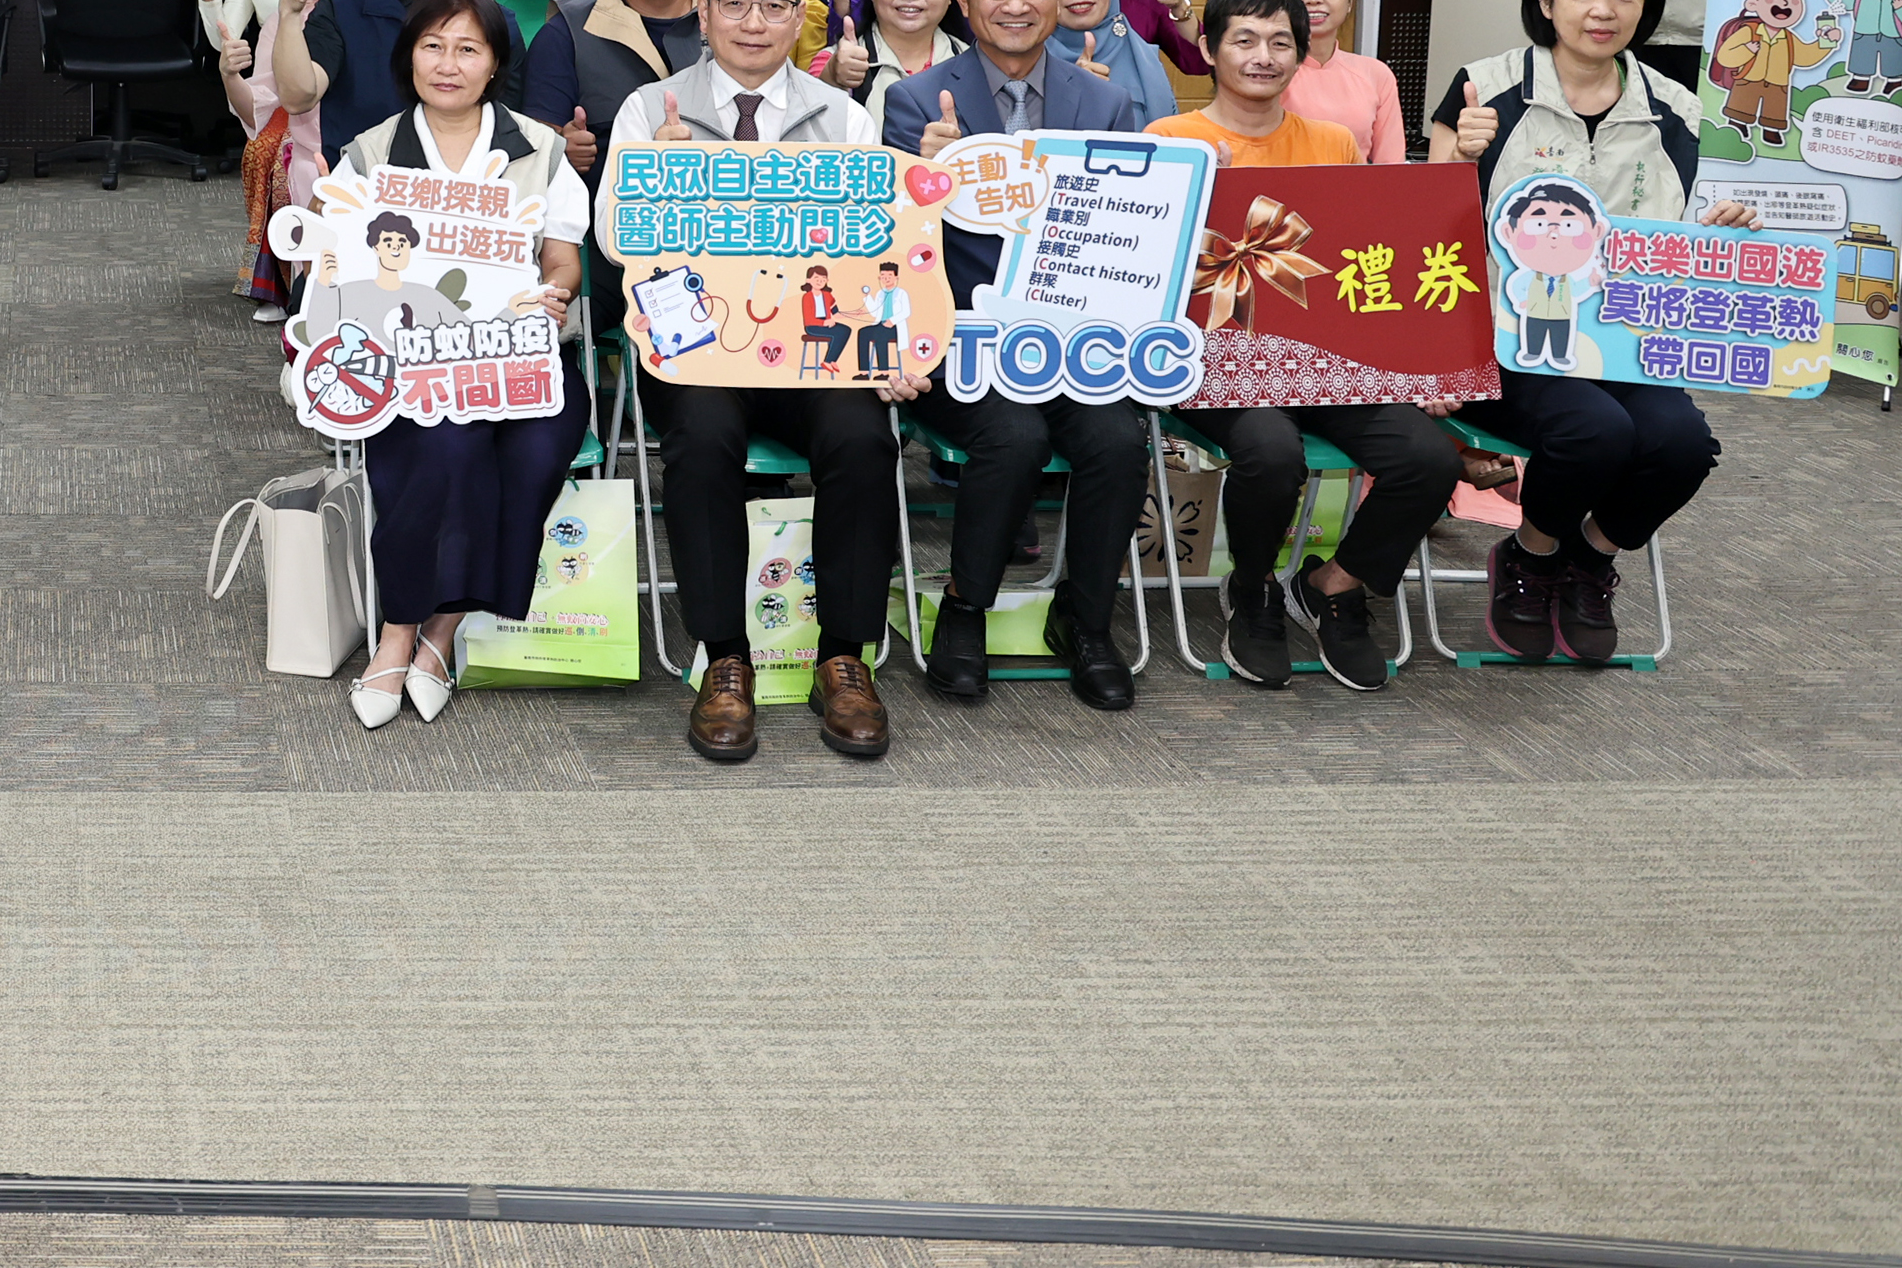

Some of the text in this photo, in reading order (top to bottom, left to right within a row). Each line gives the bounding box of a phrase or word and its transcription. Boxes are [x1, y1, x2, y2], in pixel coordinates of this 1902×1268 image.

[1812, 111, 1902, 135] 使用衛生福利部核
[374, 171, 511, 219] 返鄉探親
[614, 149, 895, 203] 民眾自主通報
[1054, 174, 1100, 193] 旅遊史
[974, 181, 1035, 216] 告知
[1045, 207, 1091, 226] 職業別
[1050, 191, 1170, 220] (Travel history)
[425, 221, 528, 265] 出遊玩
[613, 203, 895, 257] 醫師主動問診
[1036, 240, 1081, 259] 接觸史
[1042, 224, 1140, 251] (Occupation)
[1029, 271, 1058, 289] 群聚
[1033, 256, 1161, 290] (Contact history)
[1334, 241, 1481, 313] 禮券
[1603, 227, 1827, 291] 快樂出國遊
[1025, 288, 1088, 311] (Cluster)
[1598, 279, 1823, 343] 莫將登革熱
[394, 315, 552, 366] 防蚊防疫
[952, 322, 1192, 392] TOCC
[1639, 333, 1774, 389] 帶回國
[400, 357, 552, 414] 不間斷
